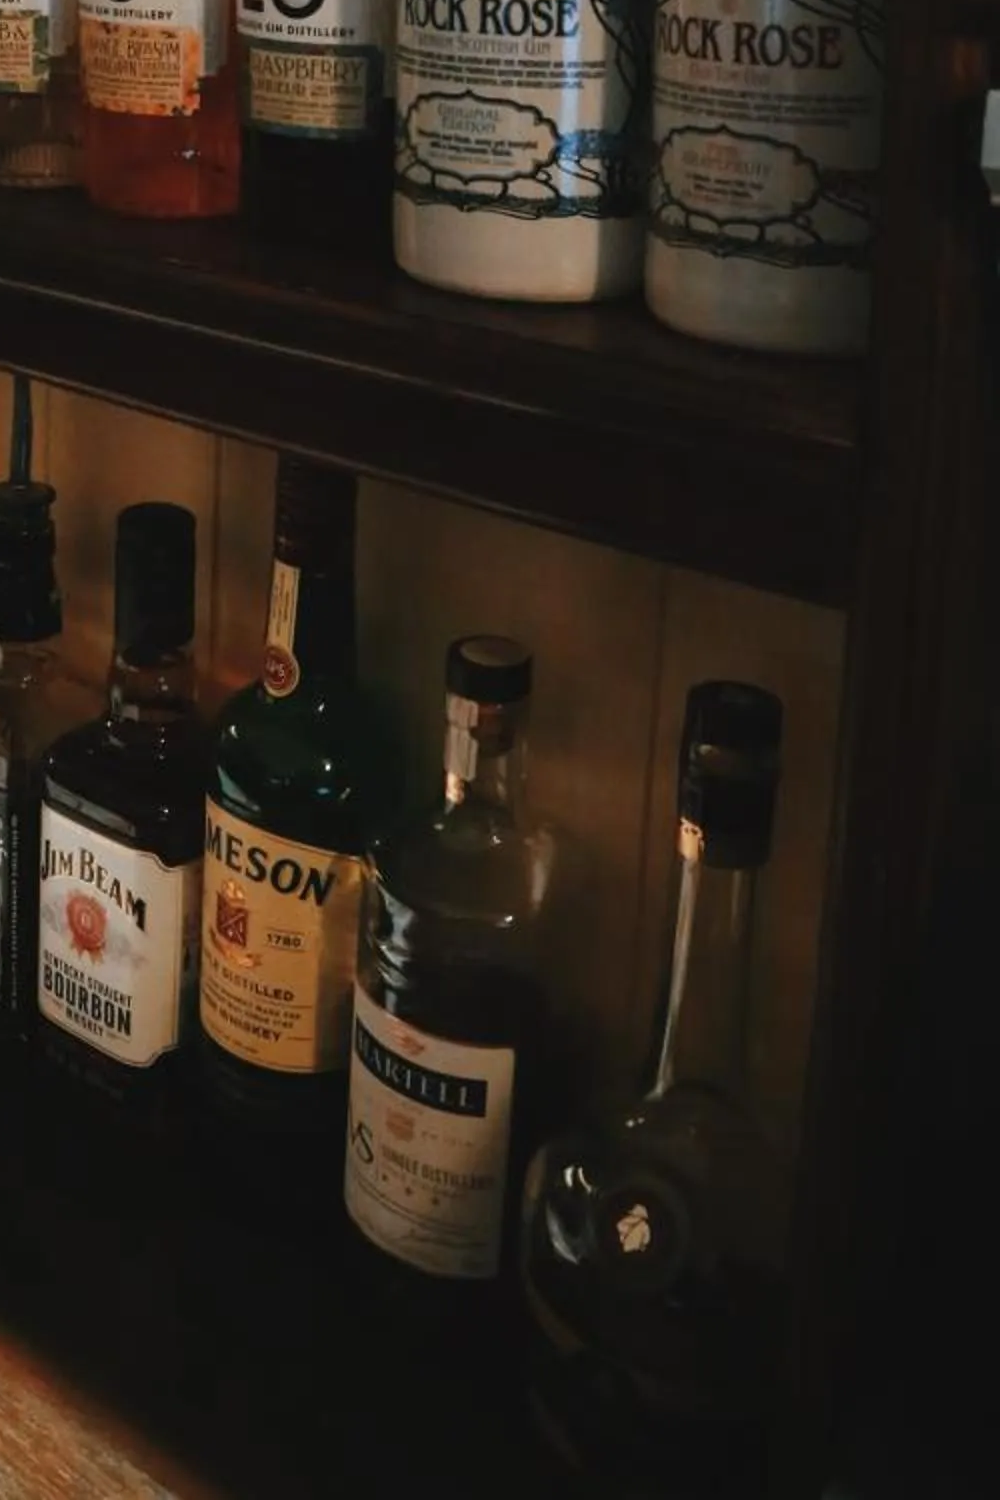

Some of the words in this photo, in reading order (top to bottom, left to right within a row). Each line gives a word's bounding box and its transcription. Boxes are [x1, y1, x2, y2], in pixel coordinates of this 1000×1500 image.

[112, 8, 173, 21] DISTILLERY
[265, 21, 283, 33] GIN
[287, 25, 355, 38] DISTILLERY
[657, 11, 722, 62] ROCK
[732, 21, 843, 70] ROSE
[253, 54, 365, 82] RASPBERRY
[205, 817, 336, 907] MESON
[41, 840, 74, 881] JIM
[79, 849, 146, 932] BEAM
[266, 932, 302, 947] 1780
[43, 963, 131, 1037] BOURBON
[222, 966, 295, 1002] DISTILLED
